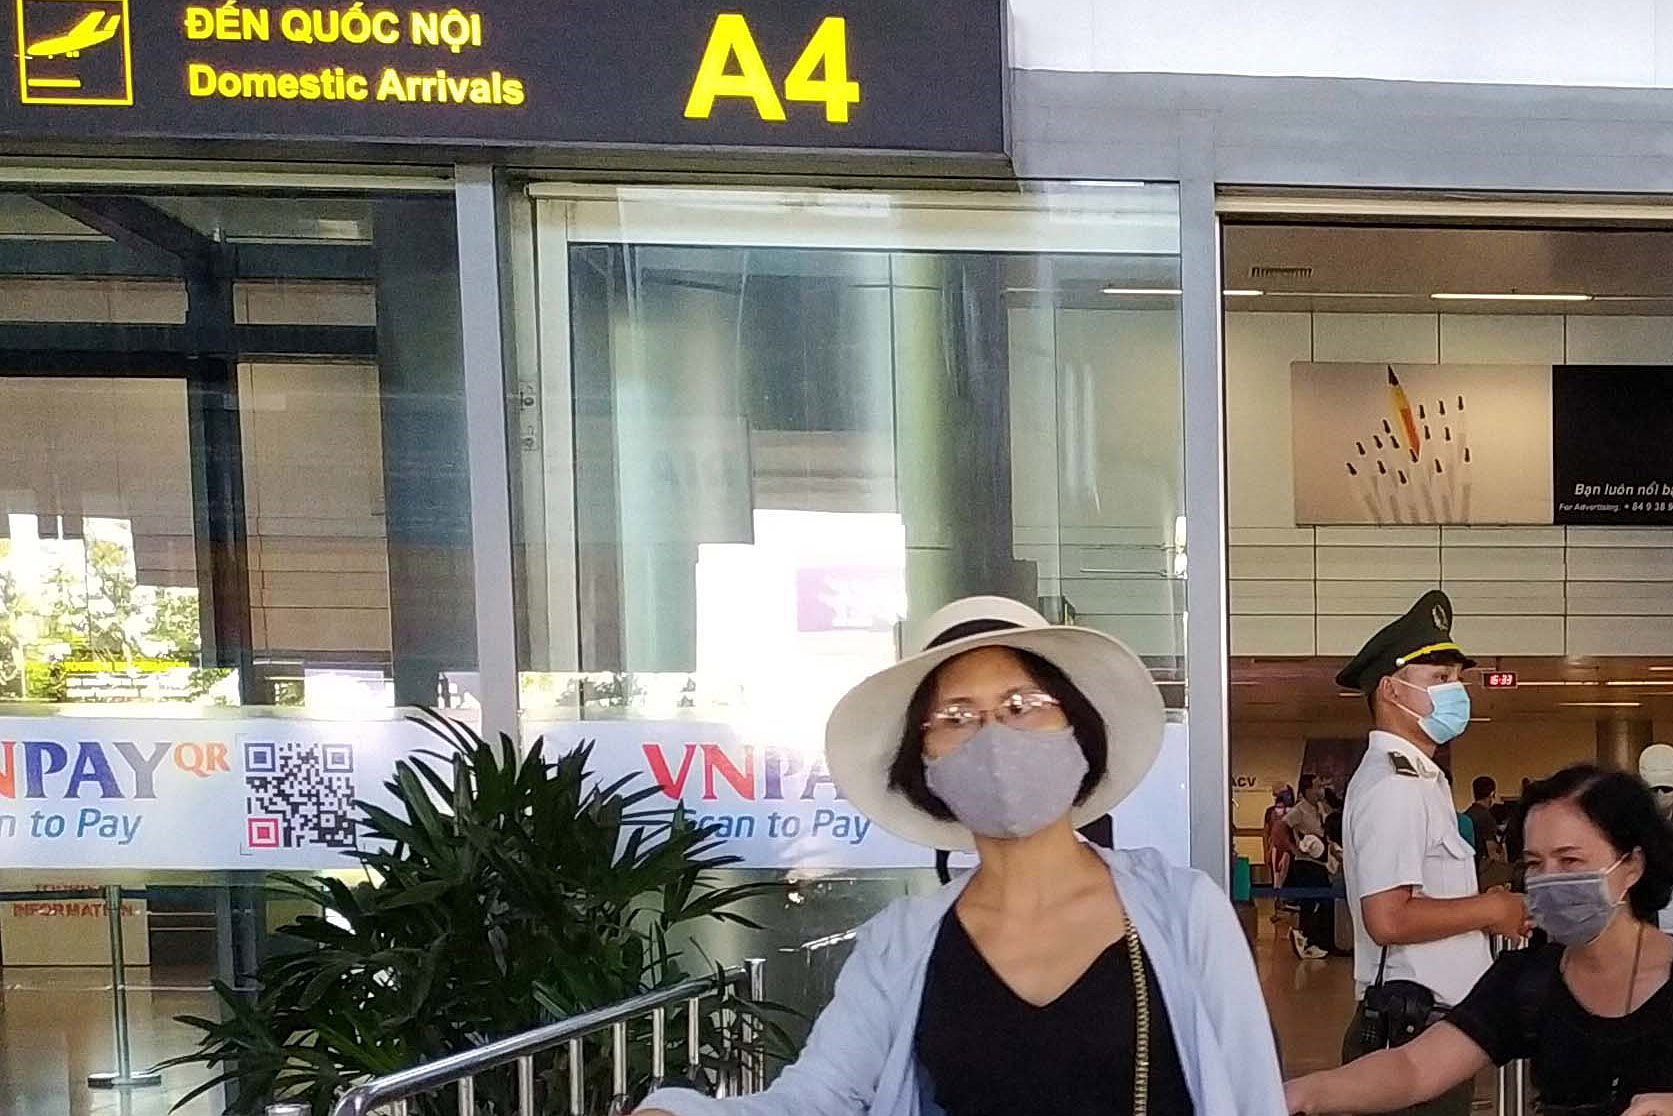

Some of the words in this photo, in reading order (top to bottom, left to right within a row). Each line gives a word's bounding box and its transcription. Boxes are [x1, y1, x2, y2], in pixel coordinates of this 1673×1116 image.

[184, 0, 270, 41] ĐẾN
[281, 2, 401, 44] QUỐC
[411, 9, 482, 53] NỘI
[188, 63, 369, 101] Domestic
[376, 68, 525, 105] Arrivals
[684, 13, 860, 123] A4
[1574, 483, 1601, 498] Bạn
[1604, 483, 1634, 496] luôn
[642, 743, 848, 800] VNPA
[31, 810, 65, 838] to
[77, 808, 143, 845] Pay
[695, 812, 755, 838] can
[767, 811, 801, 839] to
[811, 809, 872, 844] Pay
[13, 903, 133, 917] INFORMATIN
